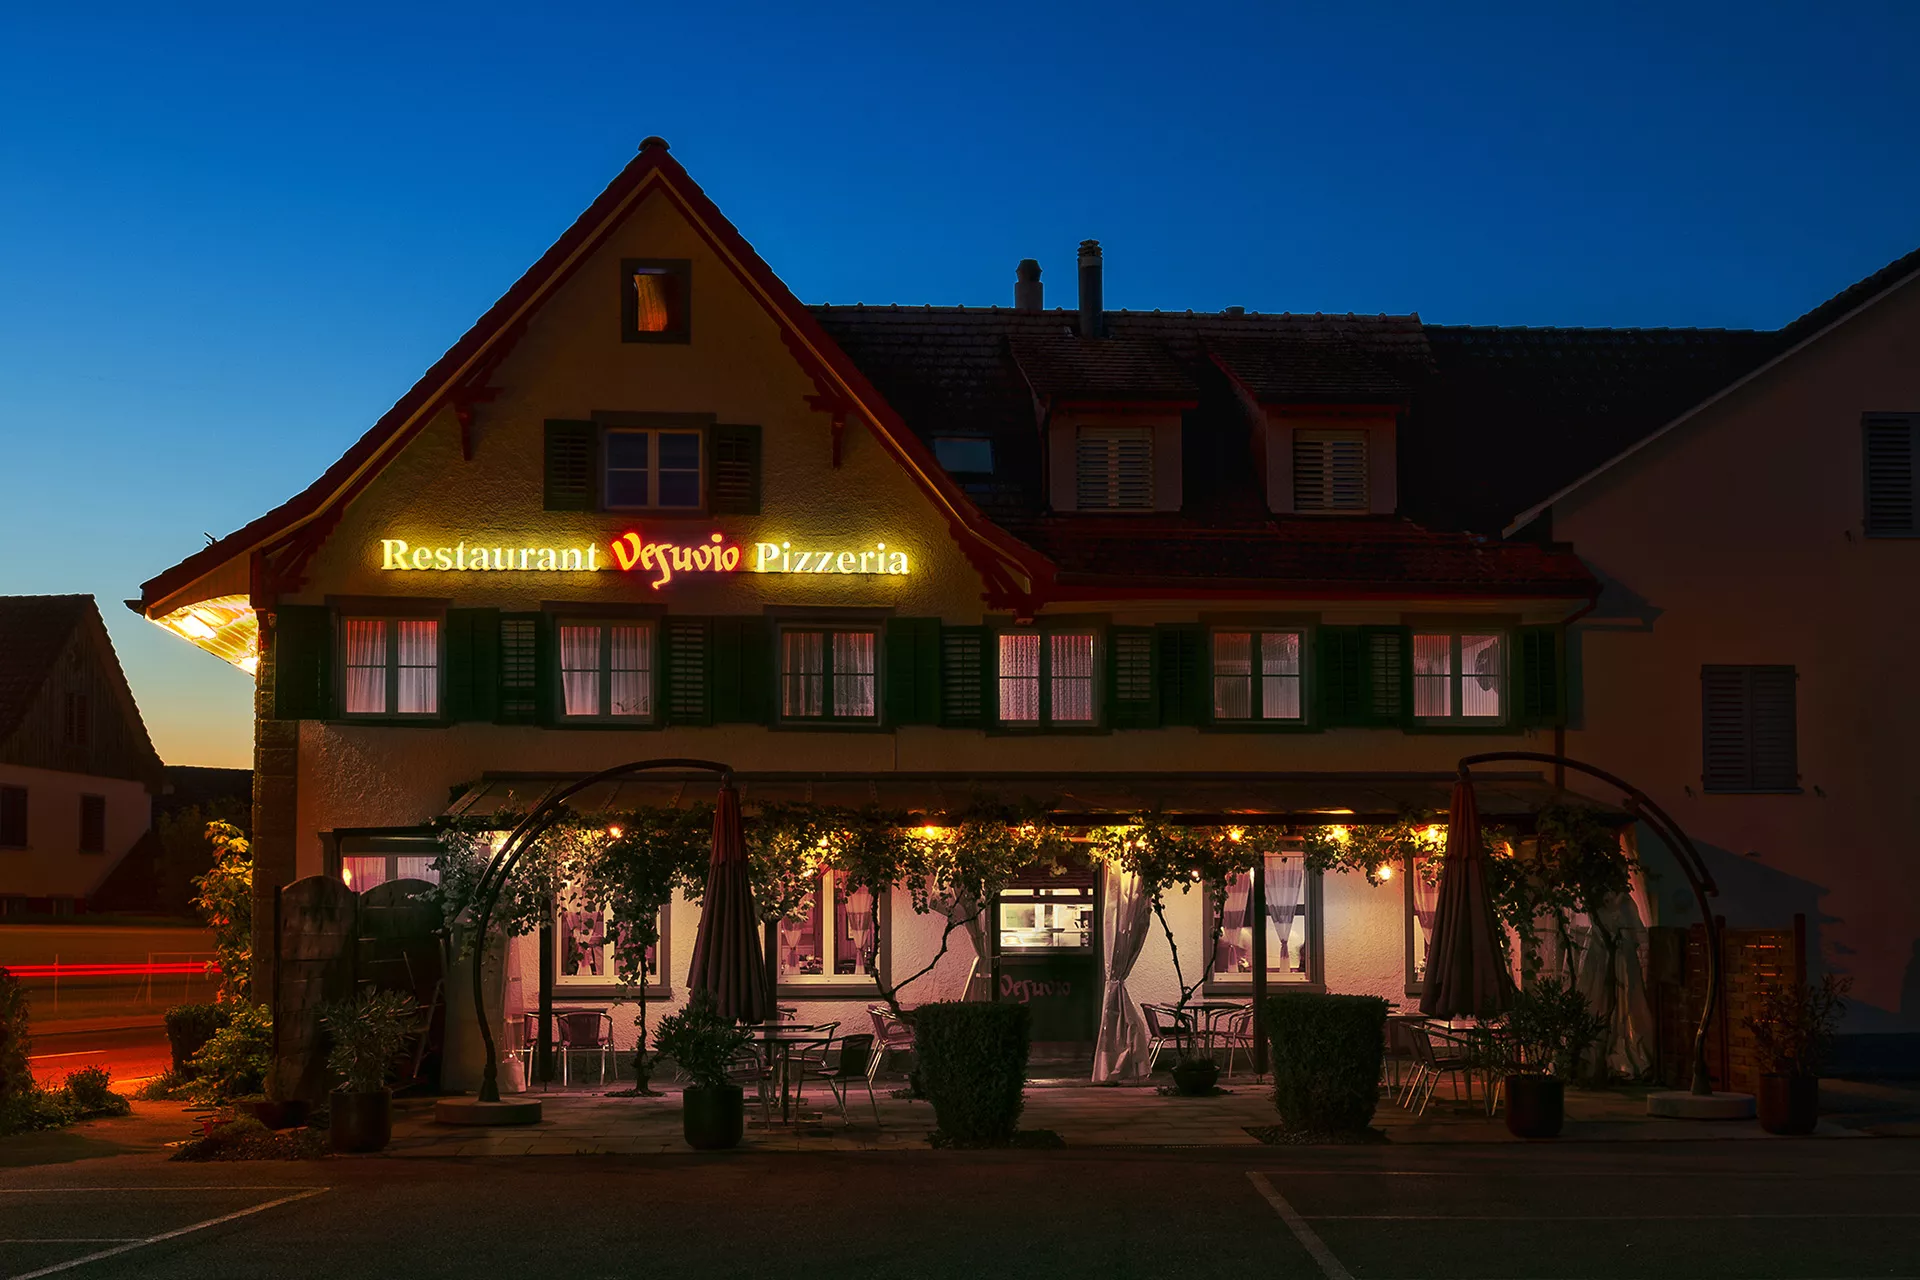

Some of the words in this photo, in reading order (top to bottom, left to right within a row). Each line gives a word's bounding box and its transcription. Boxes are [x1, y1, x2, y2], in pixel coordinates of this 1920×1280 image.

[381, 539, 600, 571] Restaurant
[611, 532, 740, 589] Vesuvio
[754, 542, 910, 574] Pizzeria
[1000, 974, 1072, 1004] Vesuvio
